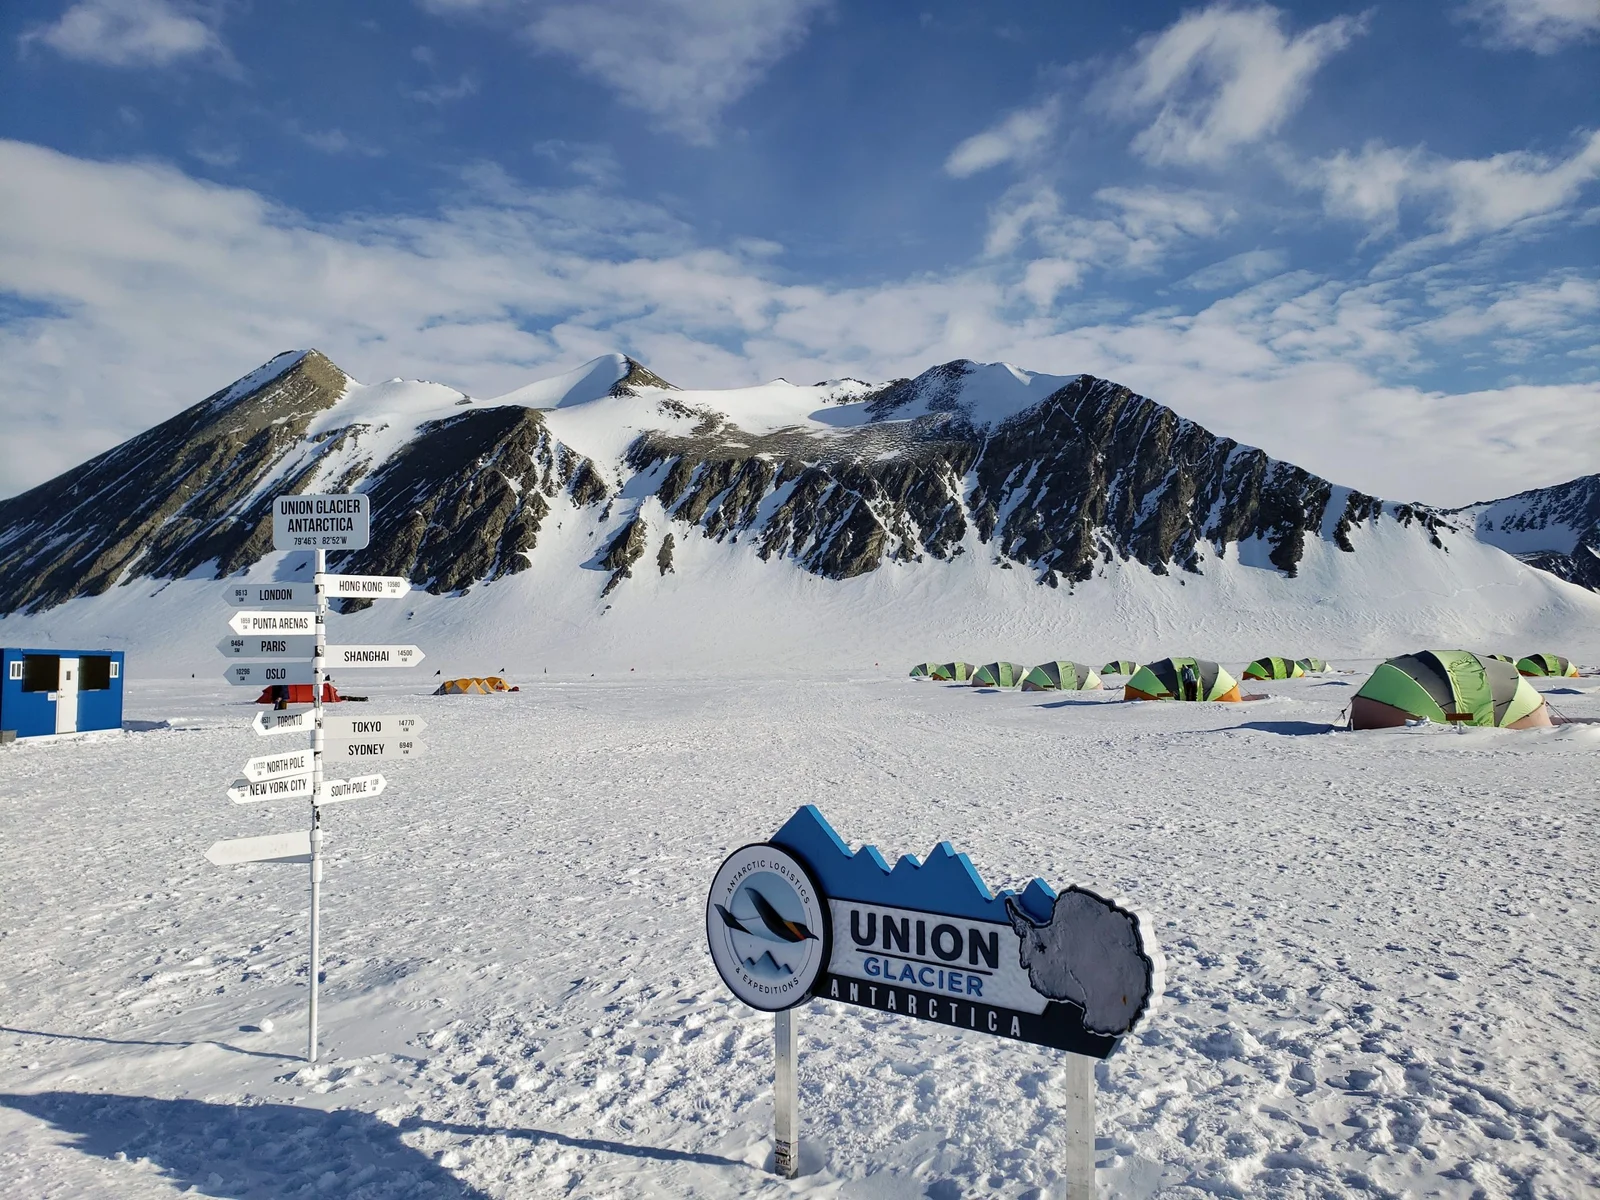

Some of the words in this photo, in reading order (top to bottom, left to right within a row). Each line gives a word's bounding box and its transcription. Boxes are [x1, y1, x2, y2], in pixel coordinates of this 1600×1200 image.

[281, 501, 313, 515] UNION
[316, 499, 361, 514] GLACIER
[287, 517, 354, 533] ANTARCTICA
[339, 580, 361, 592] HONG
[362, 581, 383, 593] KONG
[259, 589, 293, 601] LONDON
[252, 617, 278, 630] PUNTA
[278, 617, 309, 630] ARENAS
[261, 640, 287, 652] PARIS
[397, 649, 413, 657] 14500
[344, 650, 390, 662] SHANGHAI
[265, 668, 286, 680] OSLO
[276, 713, 303, 729] TORONTO
[352, 721, 381, 733] TOKYO
[348, 743, 385, 756] SYDNEY
[266, 758, 289, 774] NORTH
[289, 755, 305, 769] POLE
[249, 782, 267, 797] NEW
[268, 780, 289, 794] YORK
[290, 778, 307, 791] CITY
[330, 782, 352, 798] SOUTH
[351, 780, 367, 794] POLE
[726, 859, 767, 894] ANTARCTIC
[768, 860, 811, 906] LOGISTICS
[850, 909, 999, 970] UNION
[742, 974, 800, 994] EXPEDITIONS
[863, 956, 984, 998] GLACIER
[830, 978, 1022, 1038] ANTARCTICA
